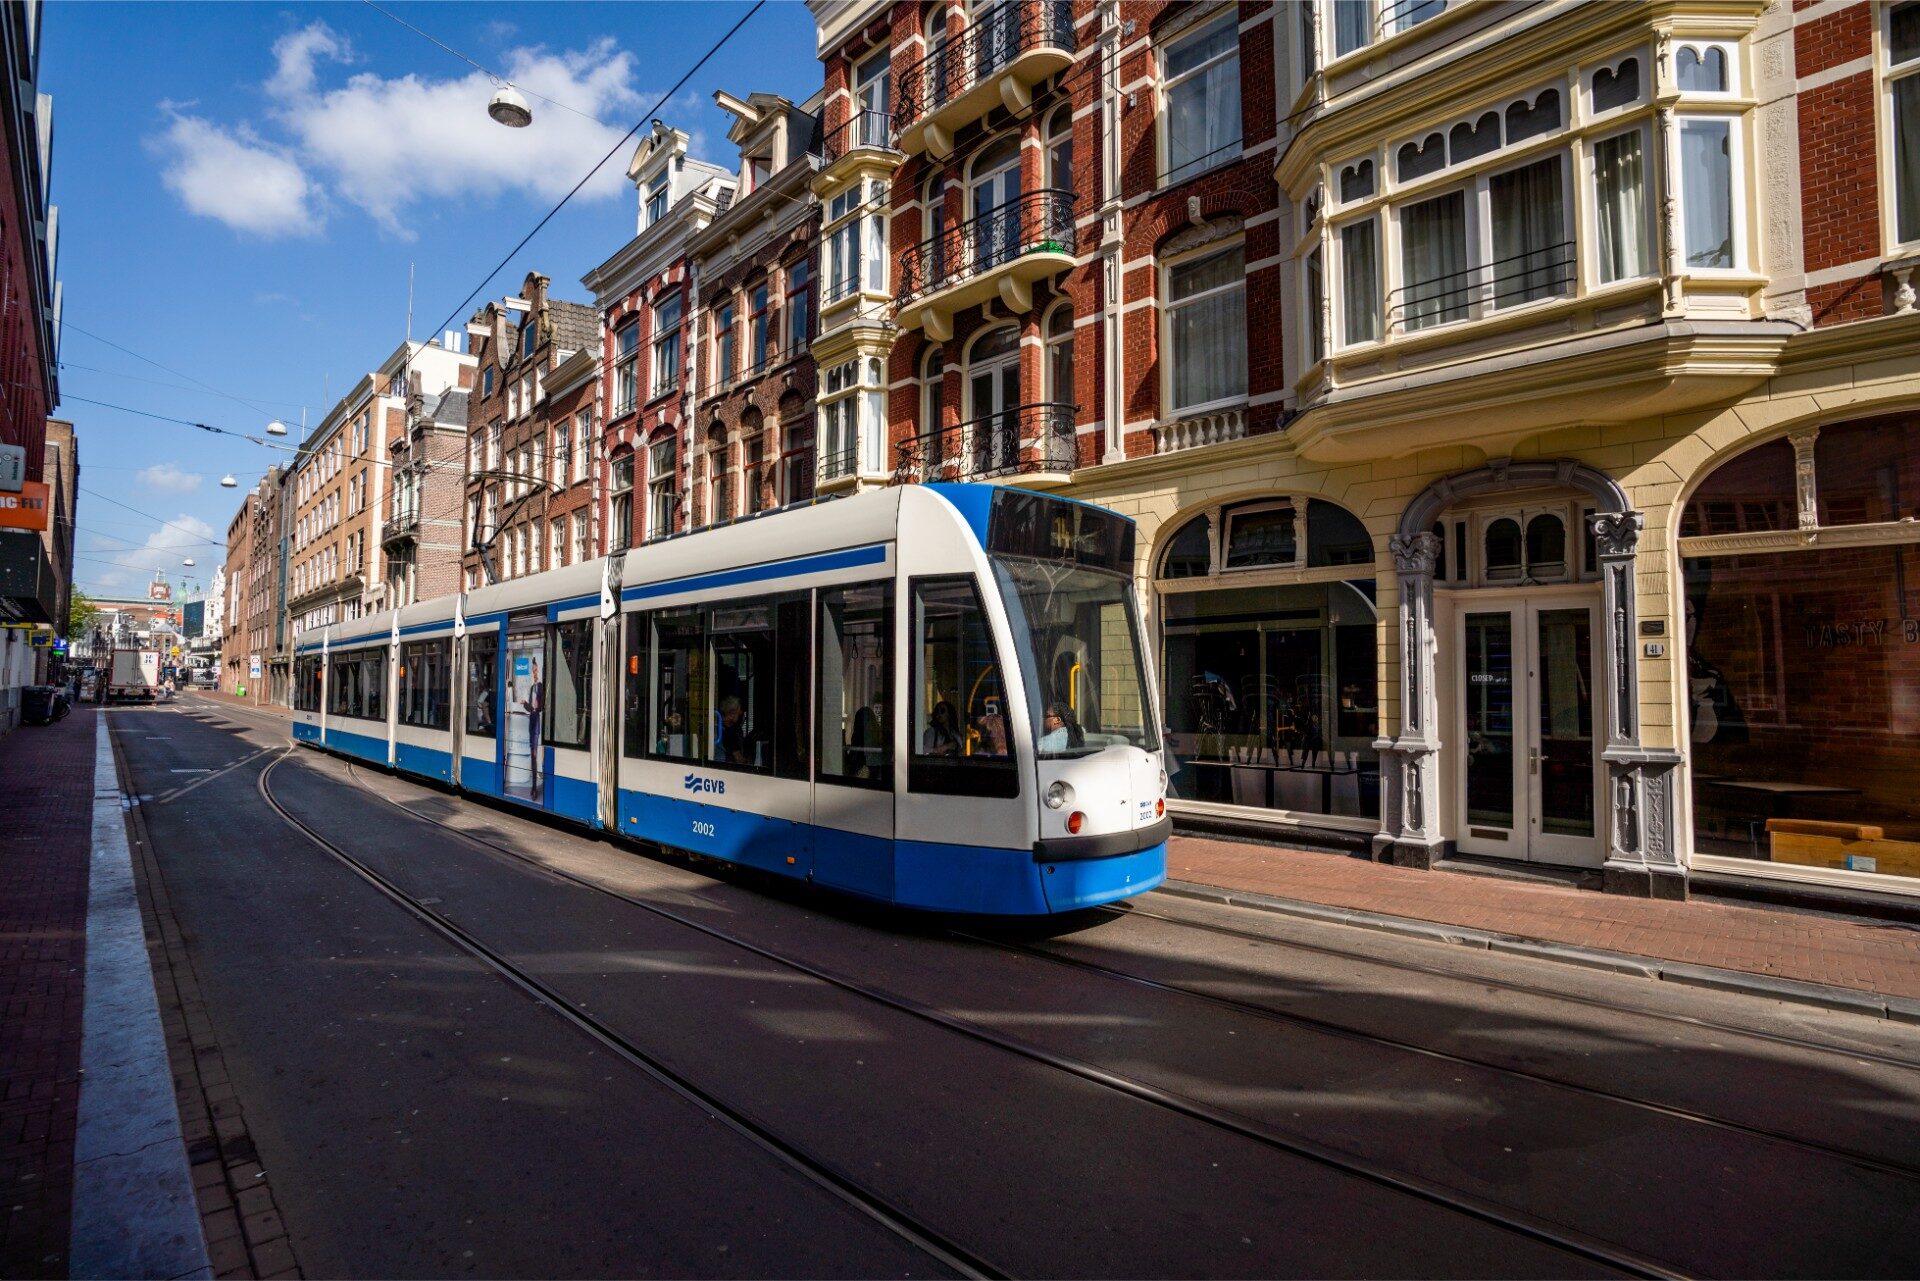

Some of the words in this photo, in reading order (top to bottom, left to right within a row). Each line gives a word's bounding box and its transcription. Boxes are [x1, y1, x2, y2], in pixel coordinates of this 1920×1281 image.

[1054, 516, 1071, 549] 14
[1804, 620, 1884, 648] TASTY
[1650, 644, 1658, 654] 41
[1471, 674, 1494, 682] CLOSED
[704, 778, 725, 794] GVB
[1139, 810, 1152, 821] 2002
[692, 820, 715, 837] 2002
